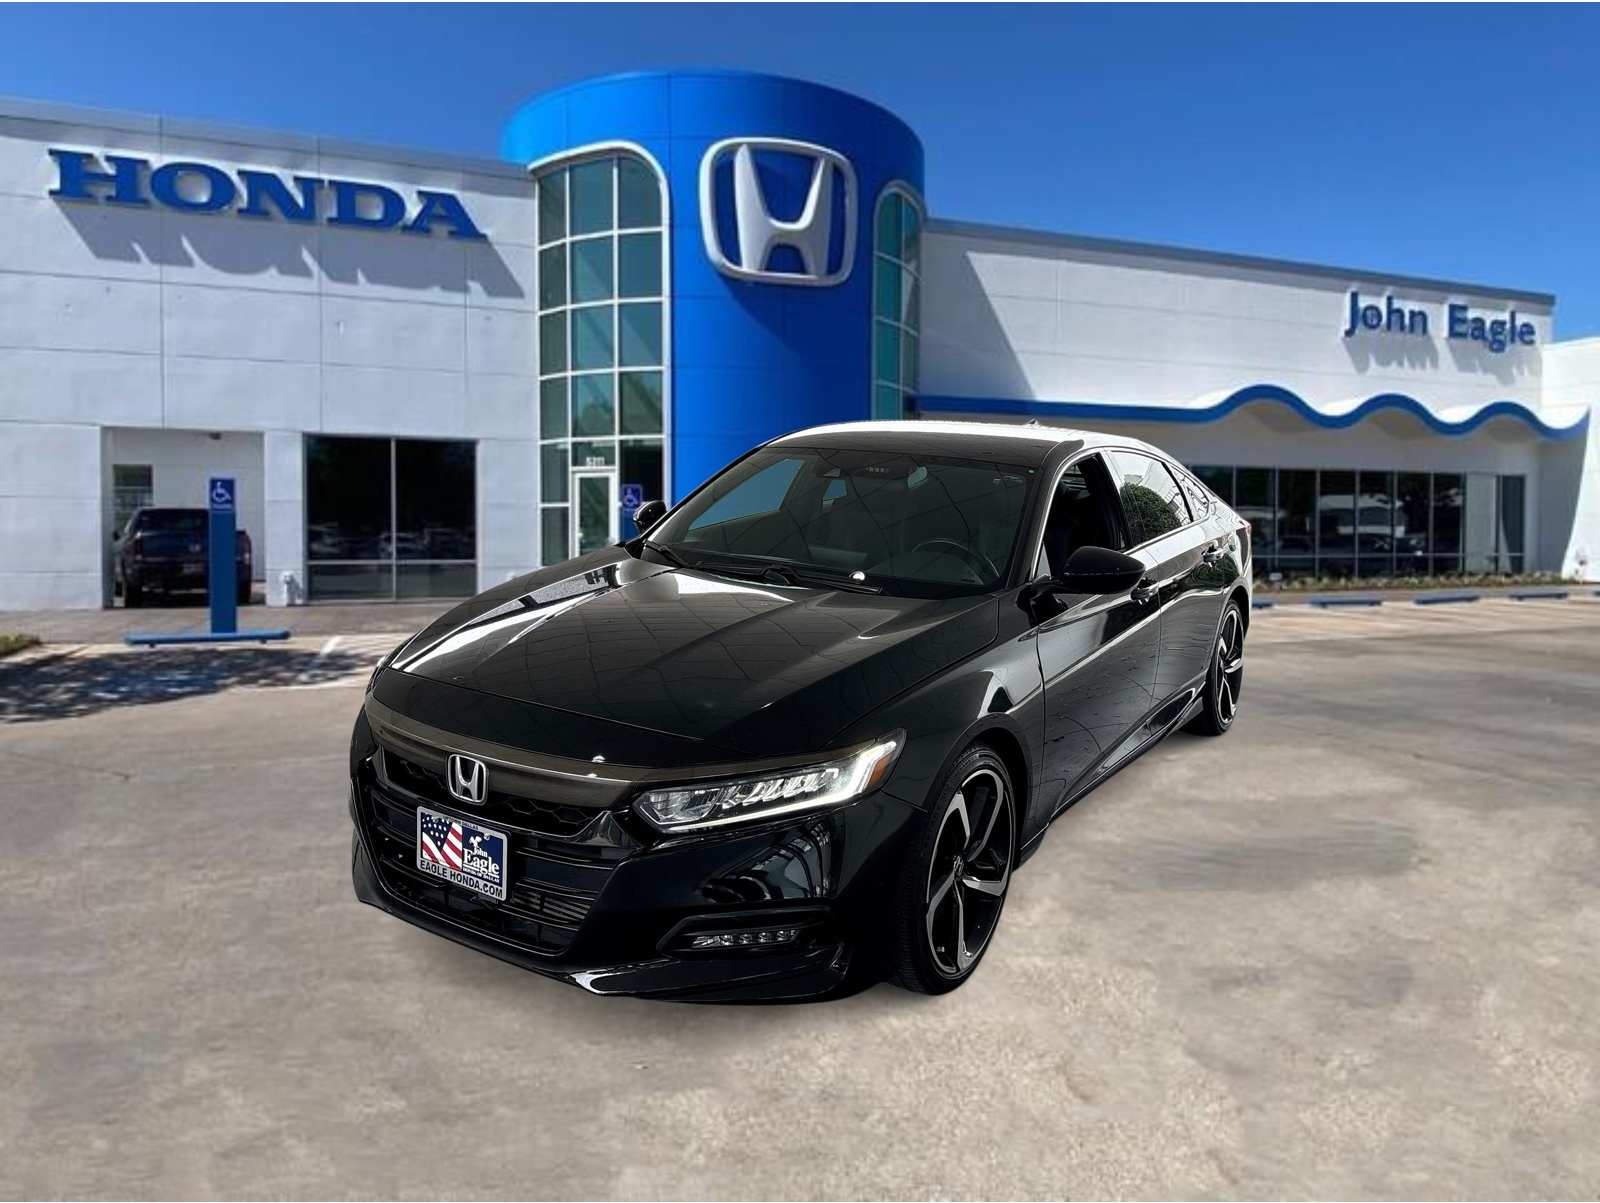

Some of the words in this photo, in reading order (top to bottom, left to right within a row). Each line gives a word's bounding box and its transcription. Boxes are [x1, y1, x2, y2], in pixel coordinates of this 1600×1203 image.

[48, 148, 487, 240] HONDA
[1344, 291, 1428, 338] John
[1448, 303, 1536, 353] Eagle
[463, 848, 500, 875] Eagle
[473, 846, 488, 857] John
[420, 860, 448, 878] EAGLE
[449, 871, 503, 899] HONDA.COM
